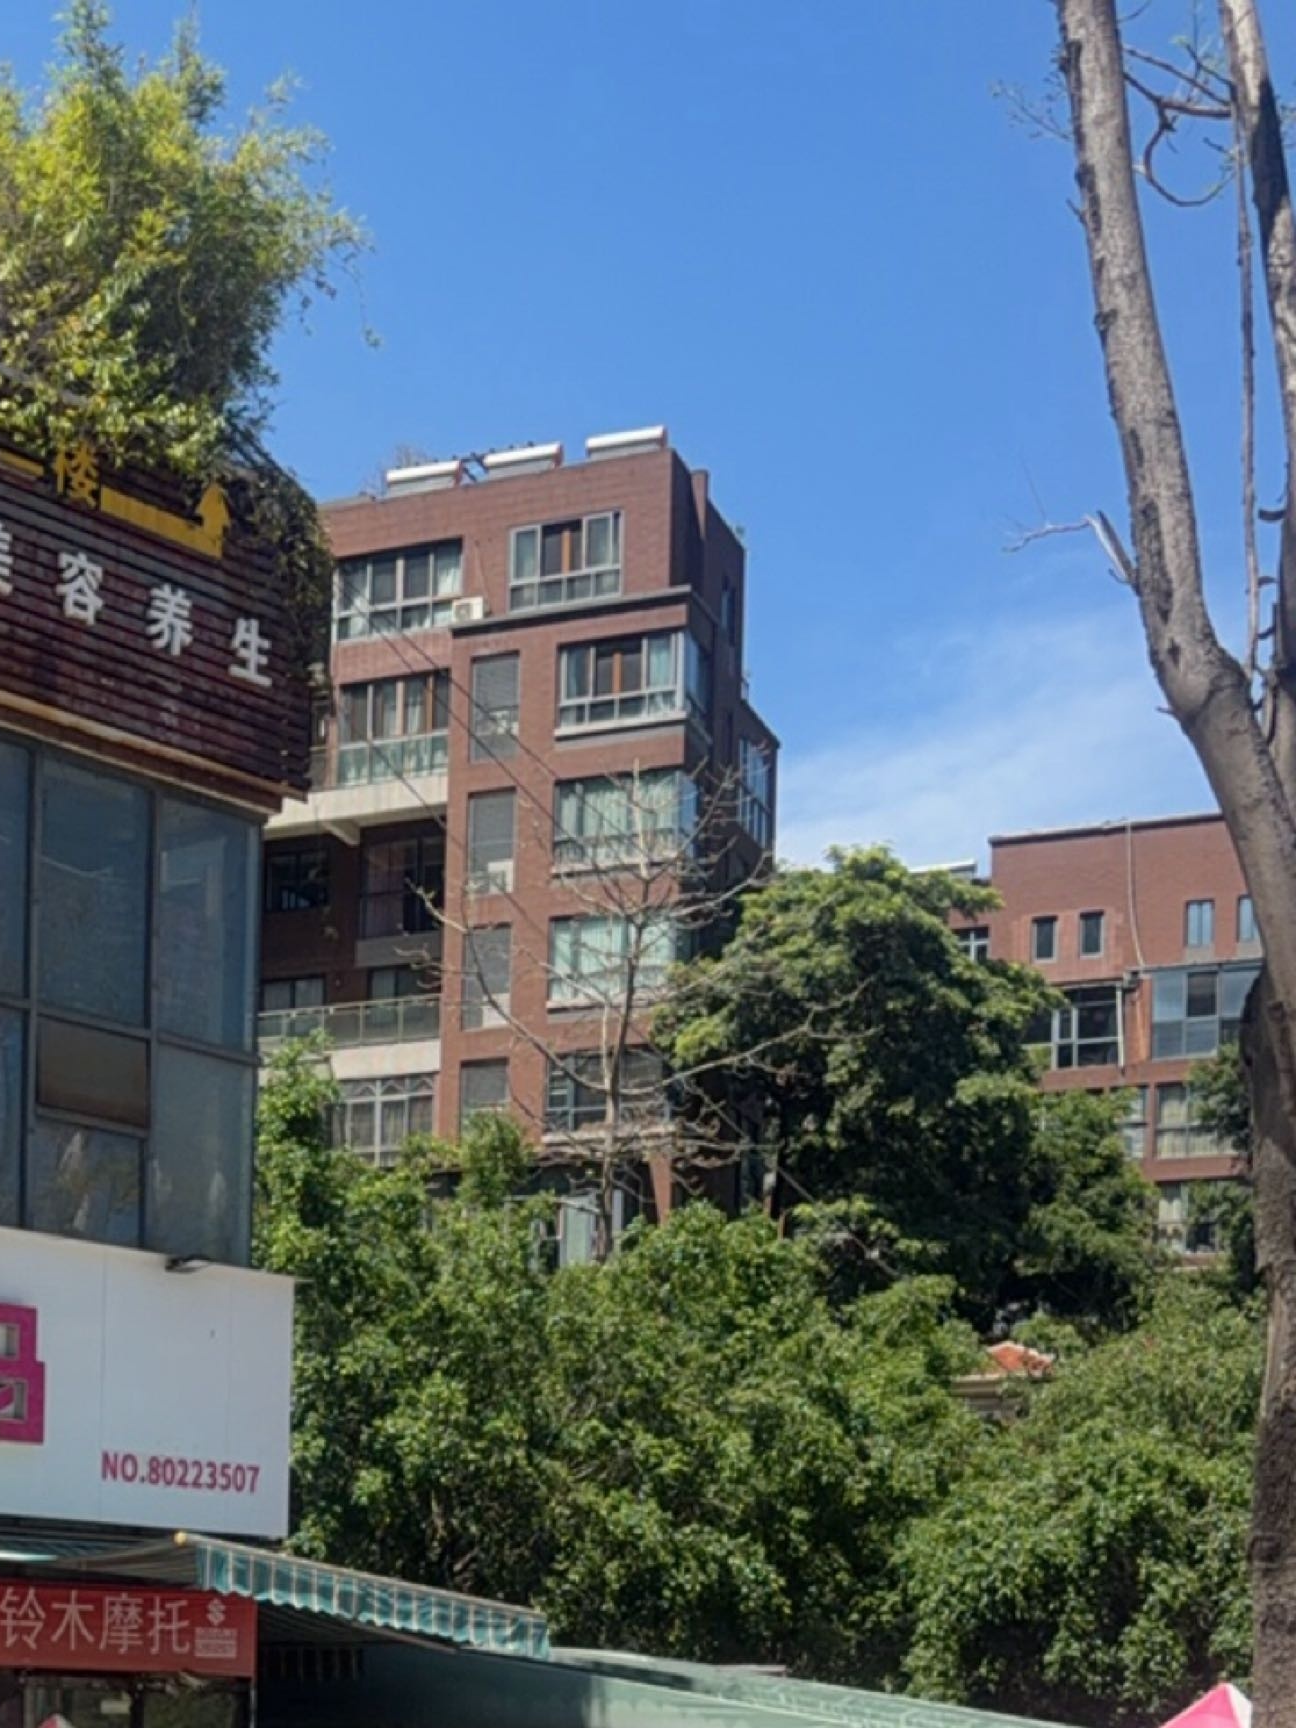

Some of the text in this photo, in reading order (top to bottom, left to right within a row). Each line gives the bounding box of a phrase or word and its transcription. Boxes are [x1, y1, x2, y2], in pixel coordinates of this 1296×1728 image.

[101, 1450, 261, 1494] NO.80223507
[0, 1585, 191, 1655] 铃木摩托
